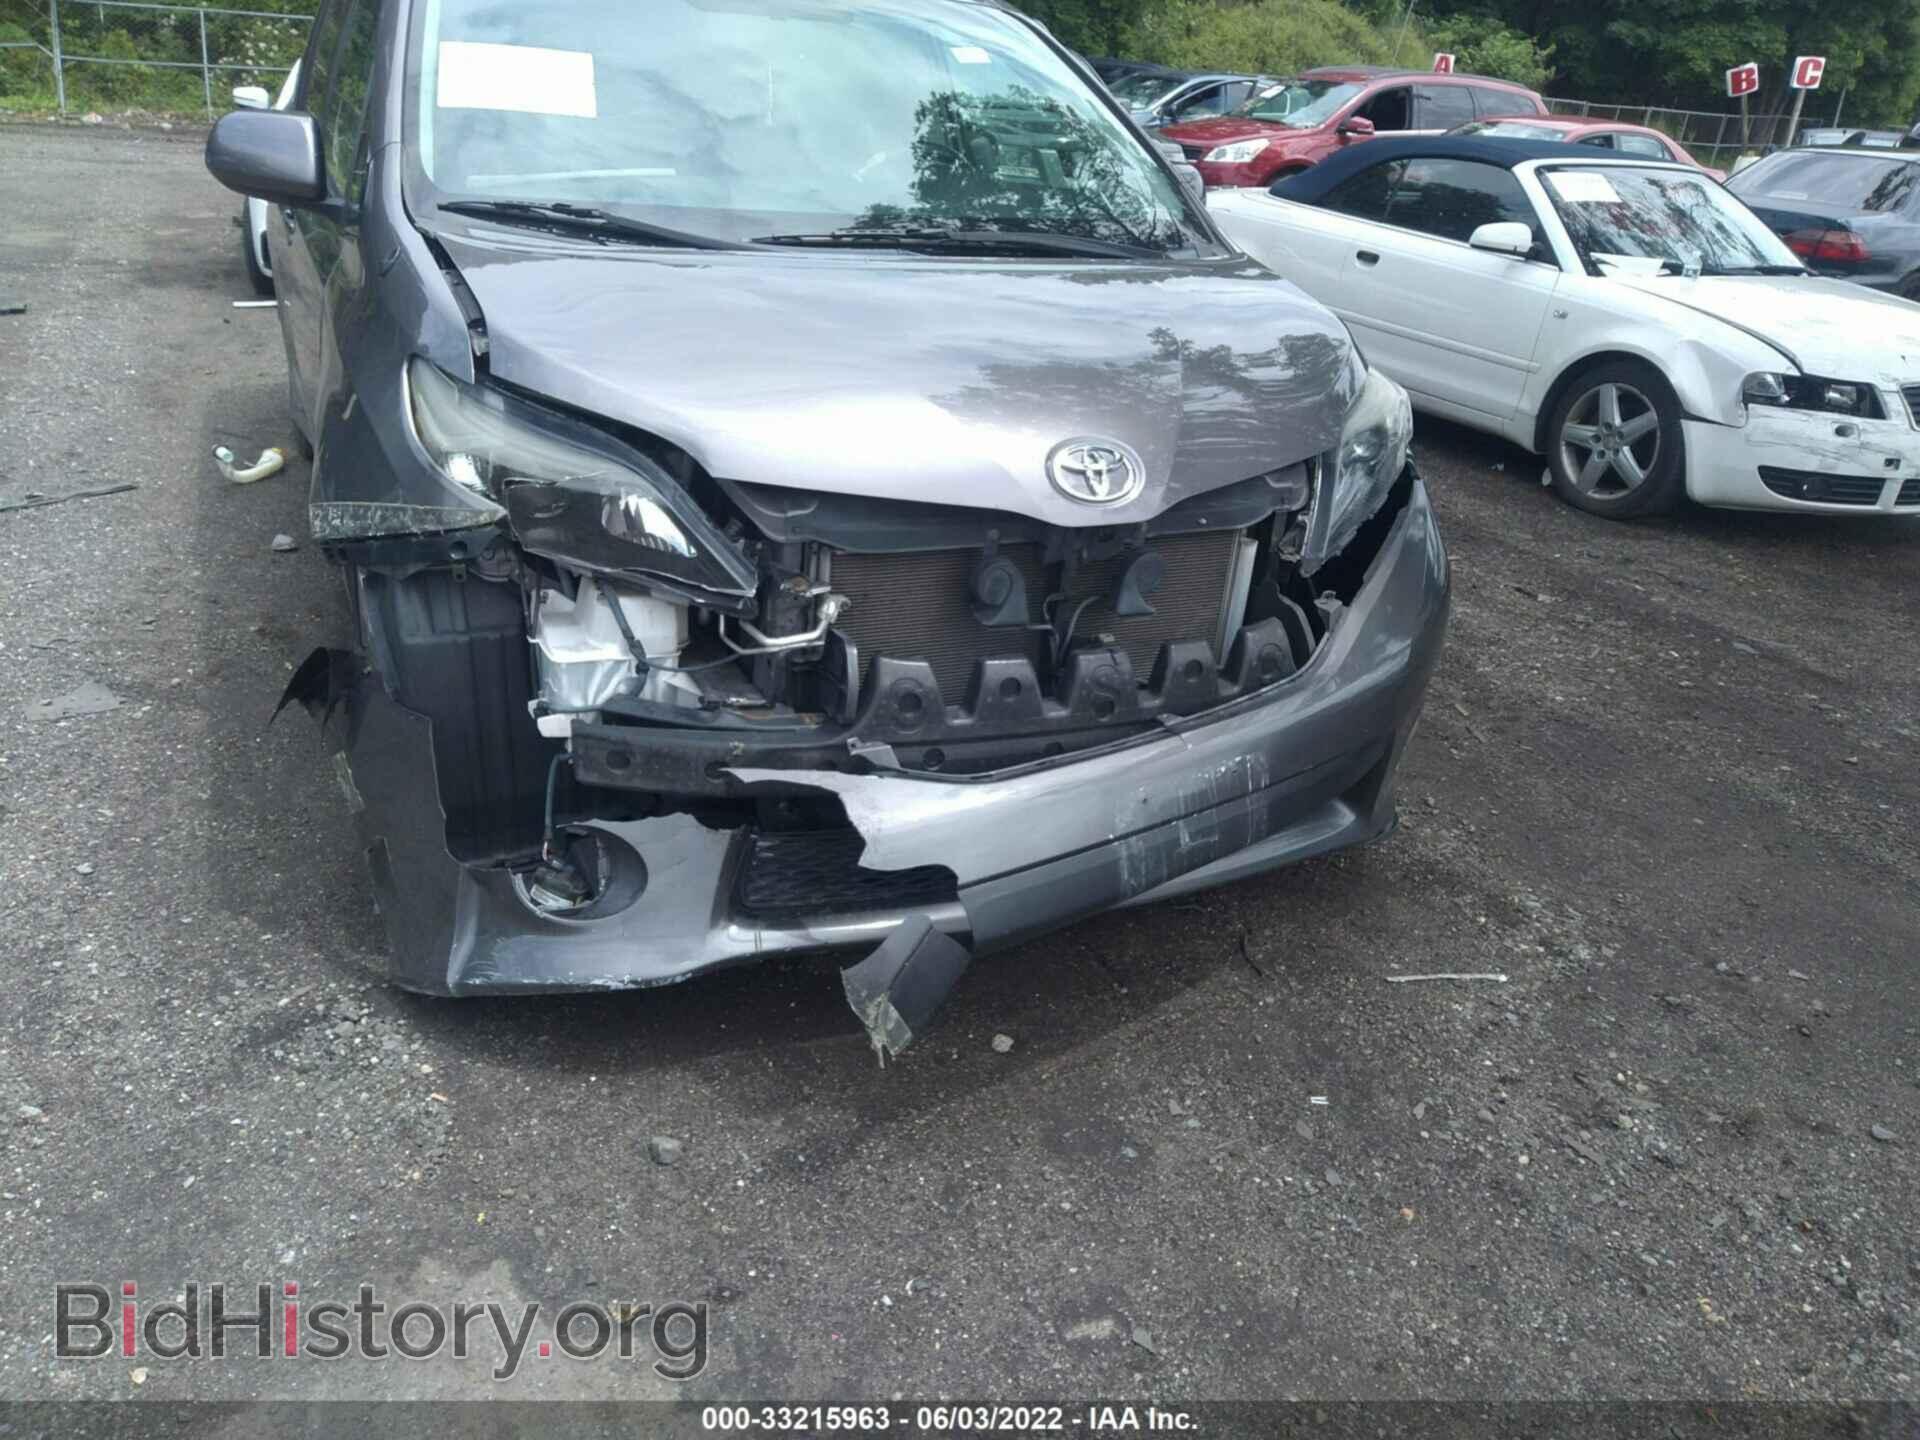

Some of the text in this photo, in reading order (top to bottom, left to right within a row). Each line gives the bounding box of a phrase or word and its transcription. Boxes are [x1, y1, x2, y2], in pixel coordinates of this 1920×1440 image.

[1434, 55, 1450, 72] A
[1796, 58, 1823, 87] C
[1731, 67, 1757, 94] B
